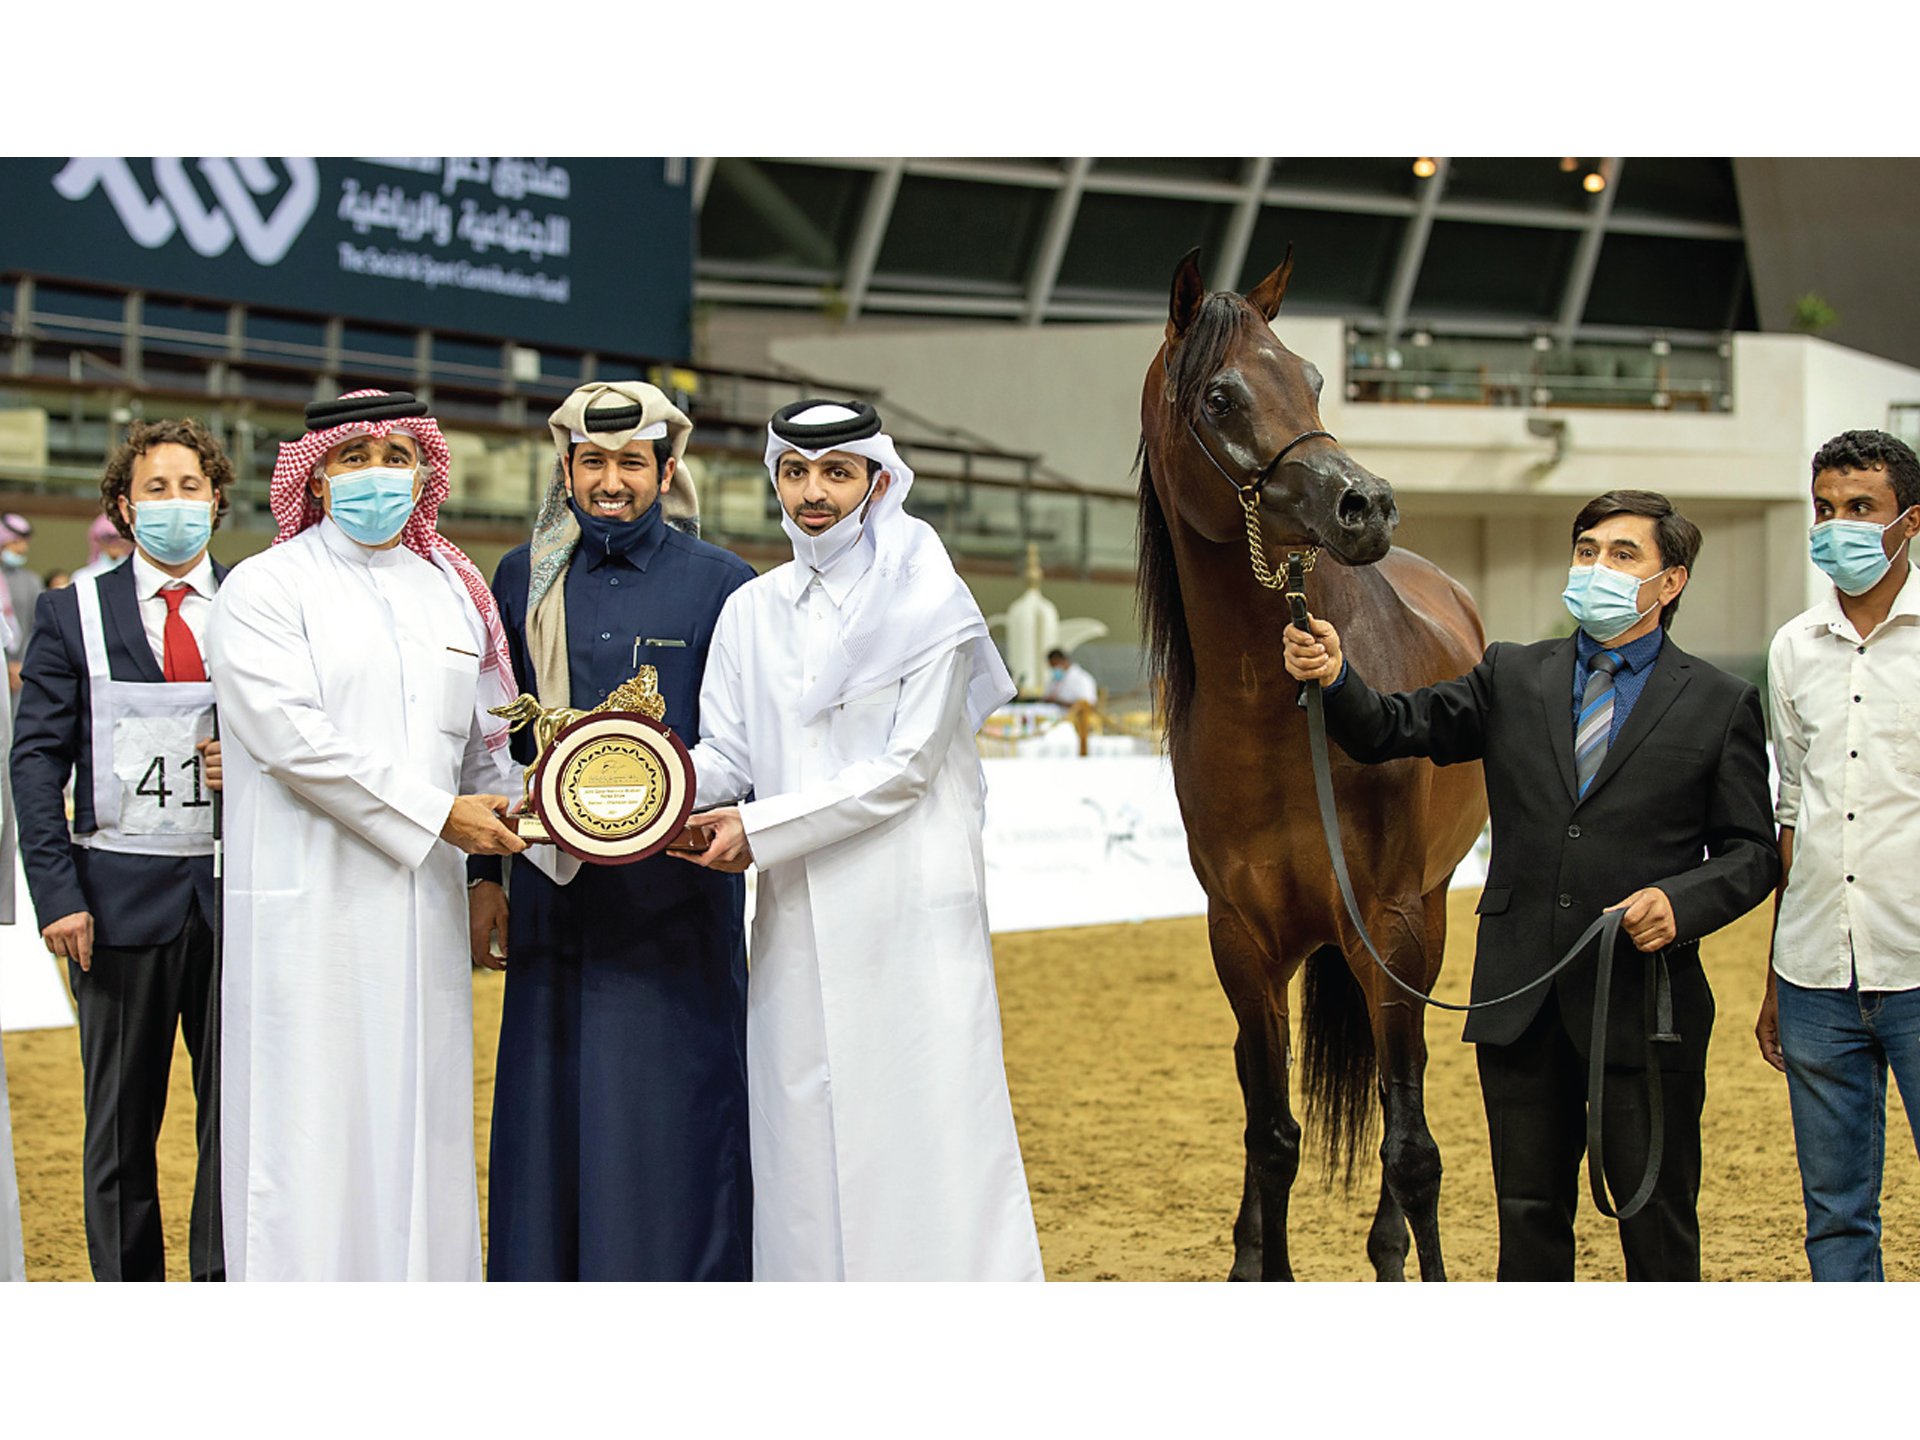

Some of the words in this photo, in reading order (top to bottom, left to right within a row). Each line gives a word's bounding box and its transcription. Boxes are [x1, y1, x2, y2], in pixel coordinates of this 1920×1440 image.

[338, 241, 365, 274] The
[365, 246, 407, 280] Social
[420, 254, 457, 290] Sport
[456, 260, 531, 298] Contribution
[531, 272, 570, 304] Fund
[136, 755, 212, 808] 41
